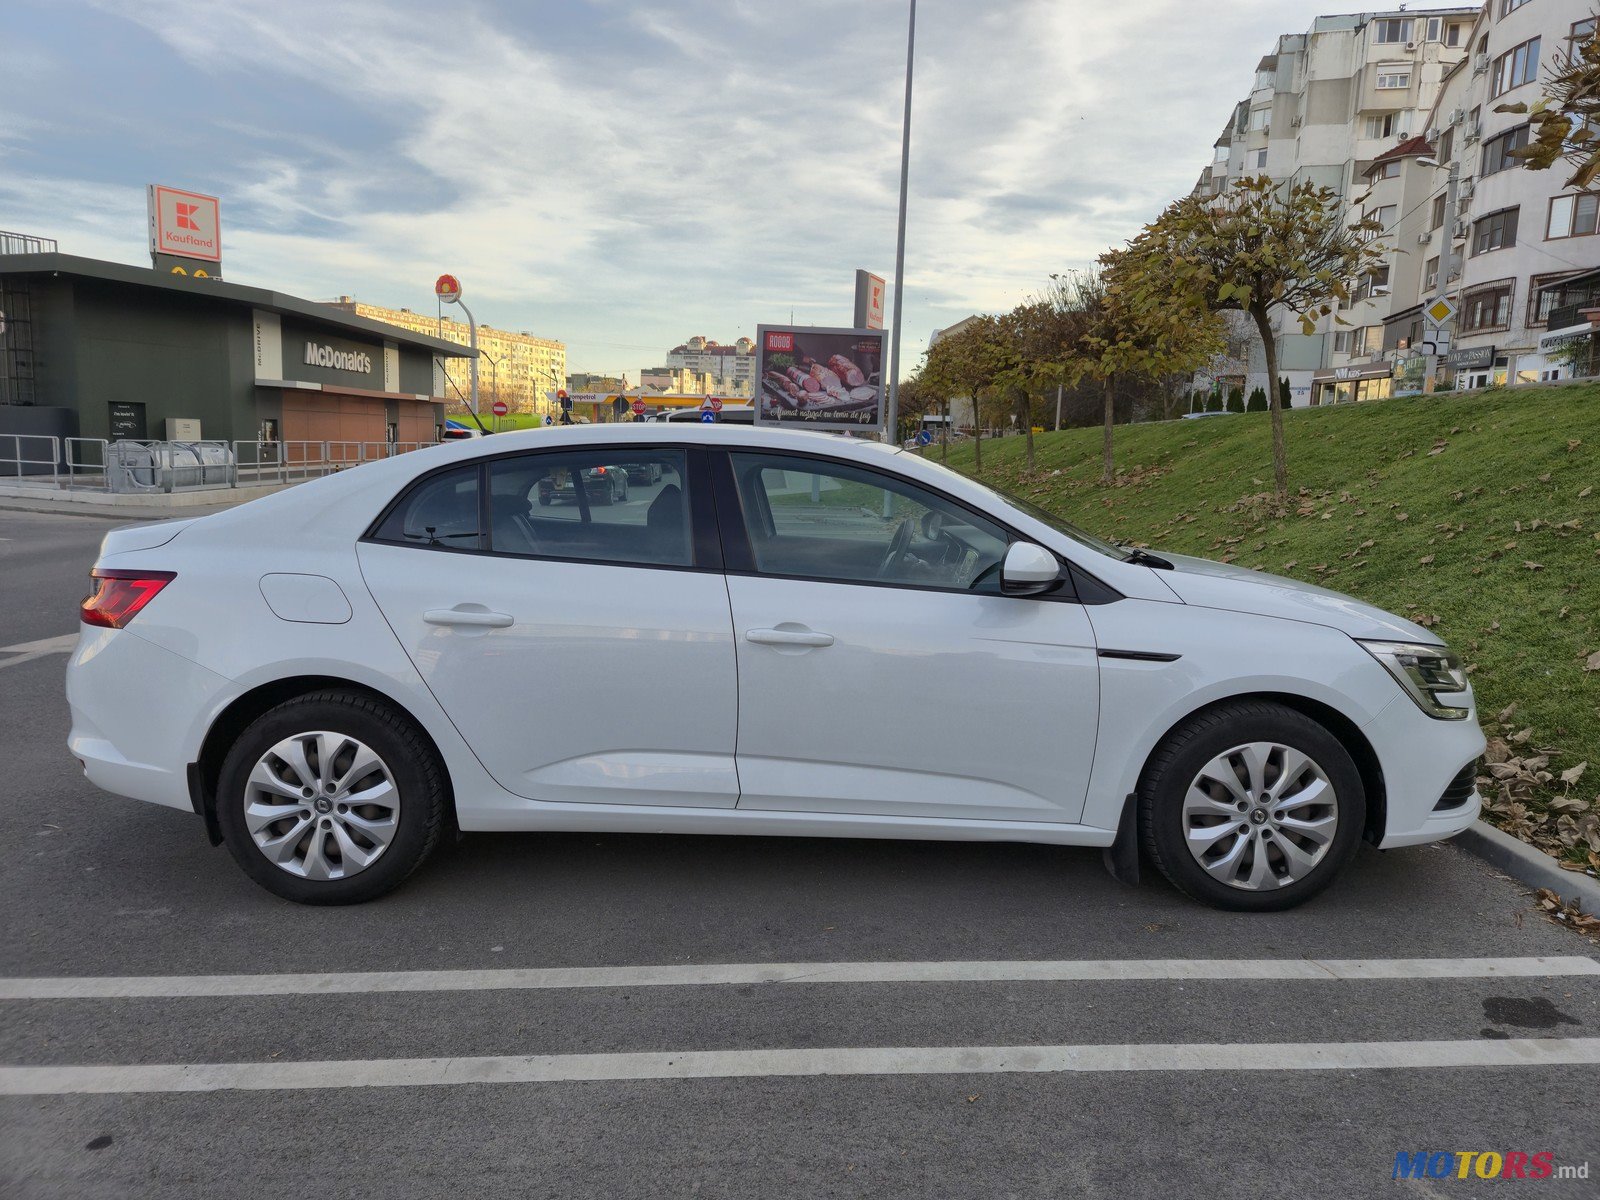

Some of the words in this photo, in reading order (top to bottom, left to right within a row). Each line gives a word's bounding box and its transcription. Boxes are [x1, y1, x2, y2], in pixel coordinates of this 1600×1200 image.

[166, 231, 213, 248] Kaufland
[769, 335, 791, 349] ROGOB
[304, 341, 371, 374] McDonald's
